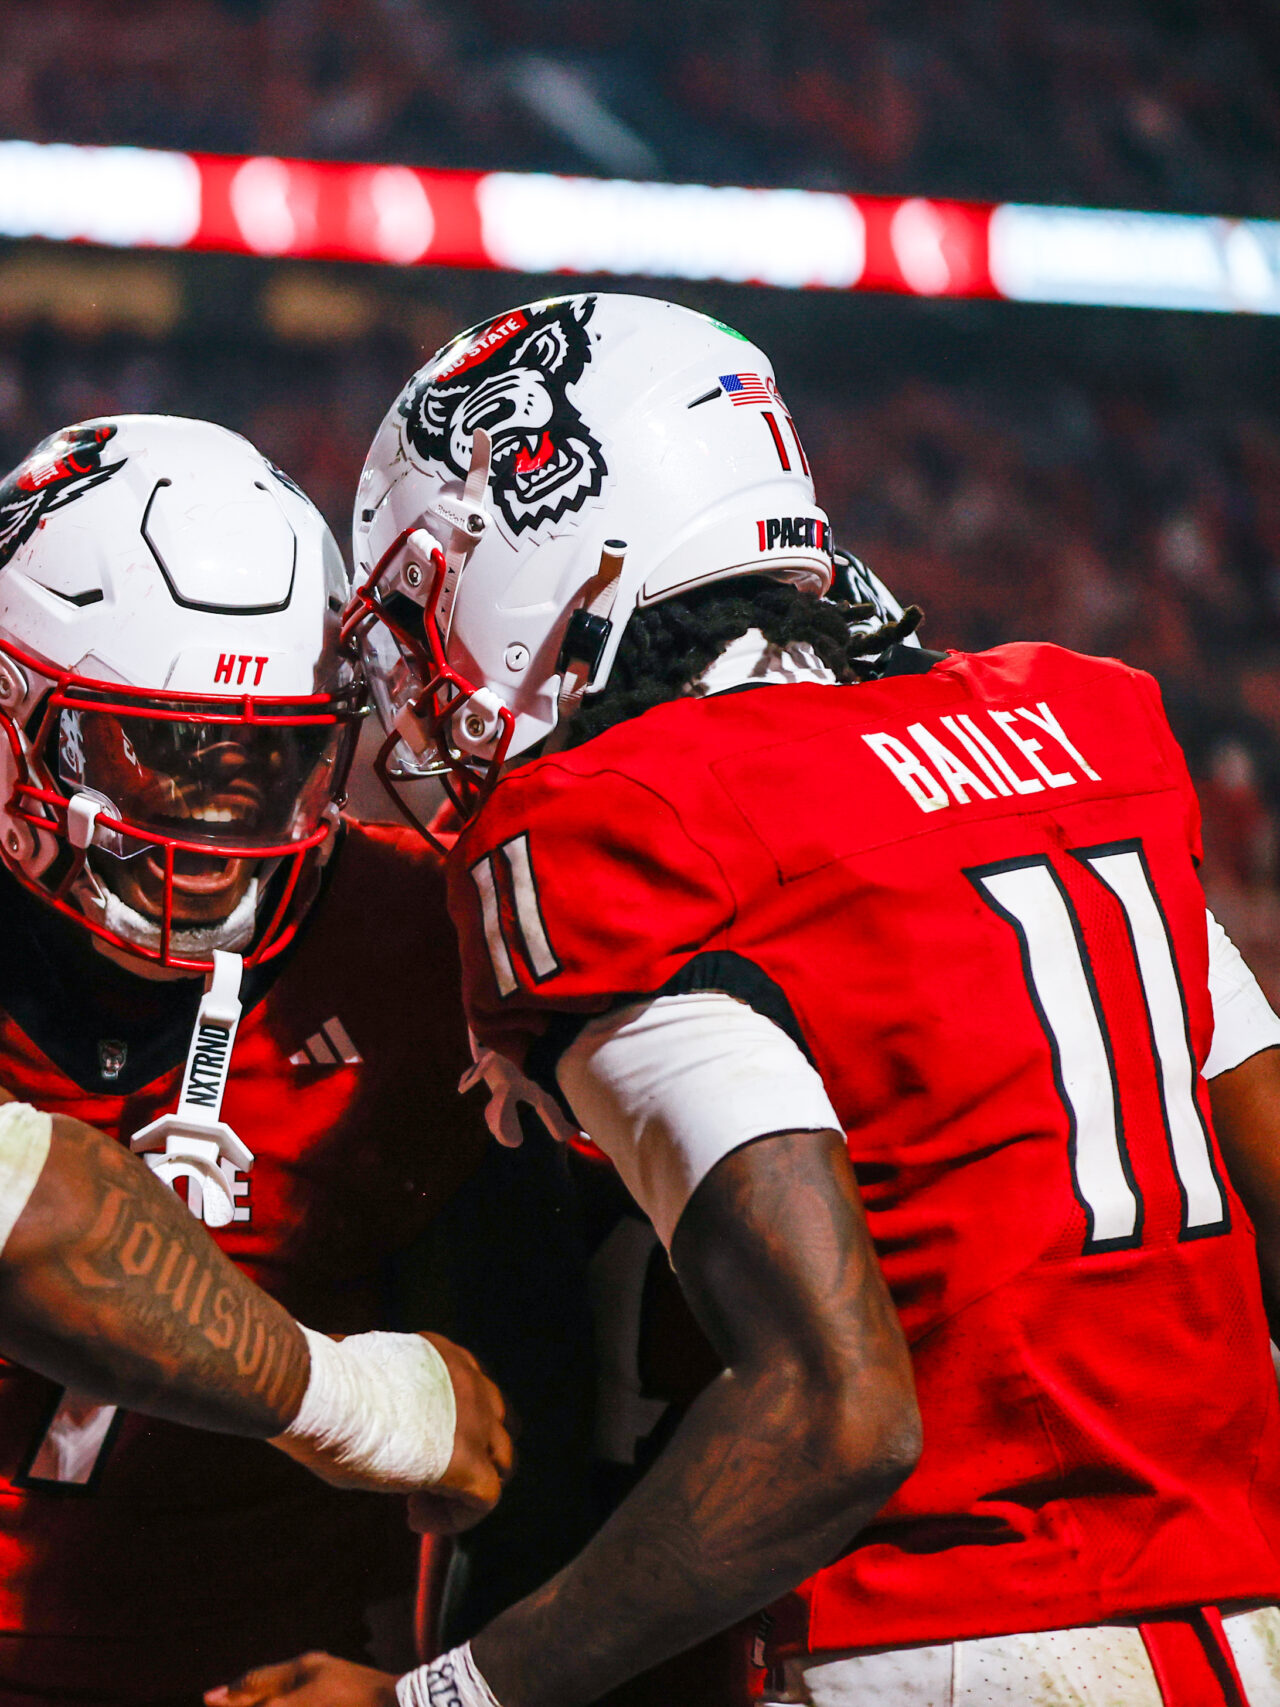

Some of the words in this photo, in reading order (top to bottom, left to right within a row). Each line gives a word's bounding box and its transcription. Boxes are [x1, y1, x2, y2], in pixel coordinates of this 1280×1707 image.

[468, 317, 521, 357] STATE
[760, 411, 811, 477] 11
[213, 653, 269, 687] HTT
[861, 702, 1103, 814] BAILEY
[468, 830, 563, 998] 11
[185, 1023, 231, 1108] NXTRND
[961, 838, 1233, 1257] 11
